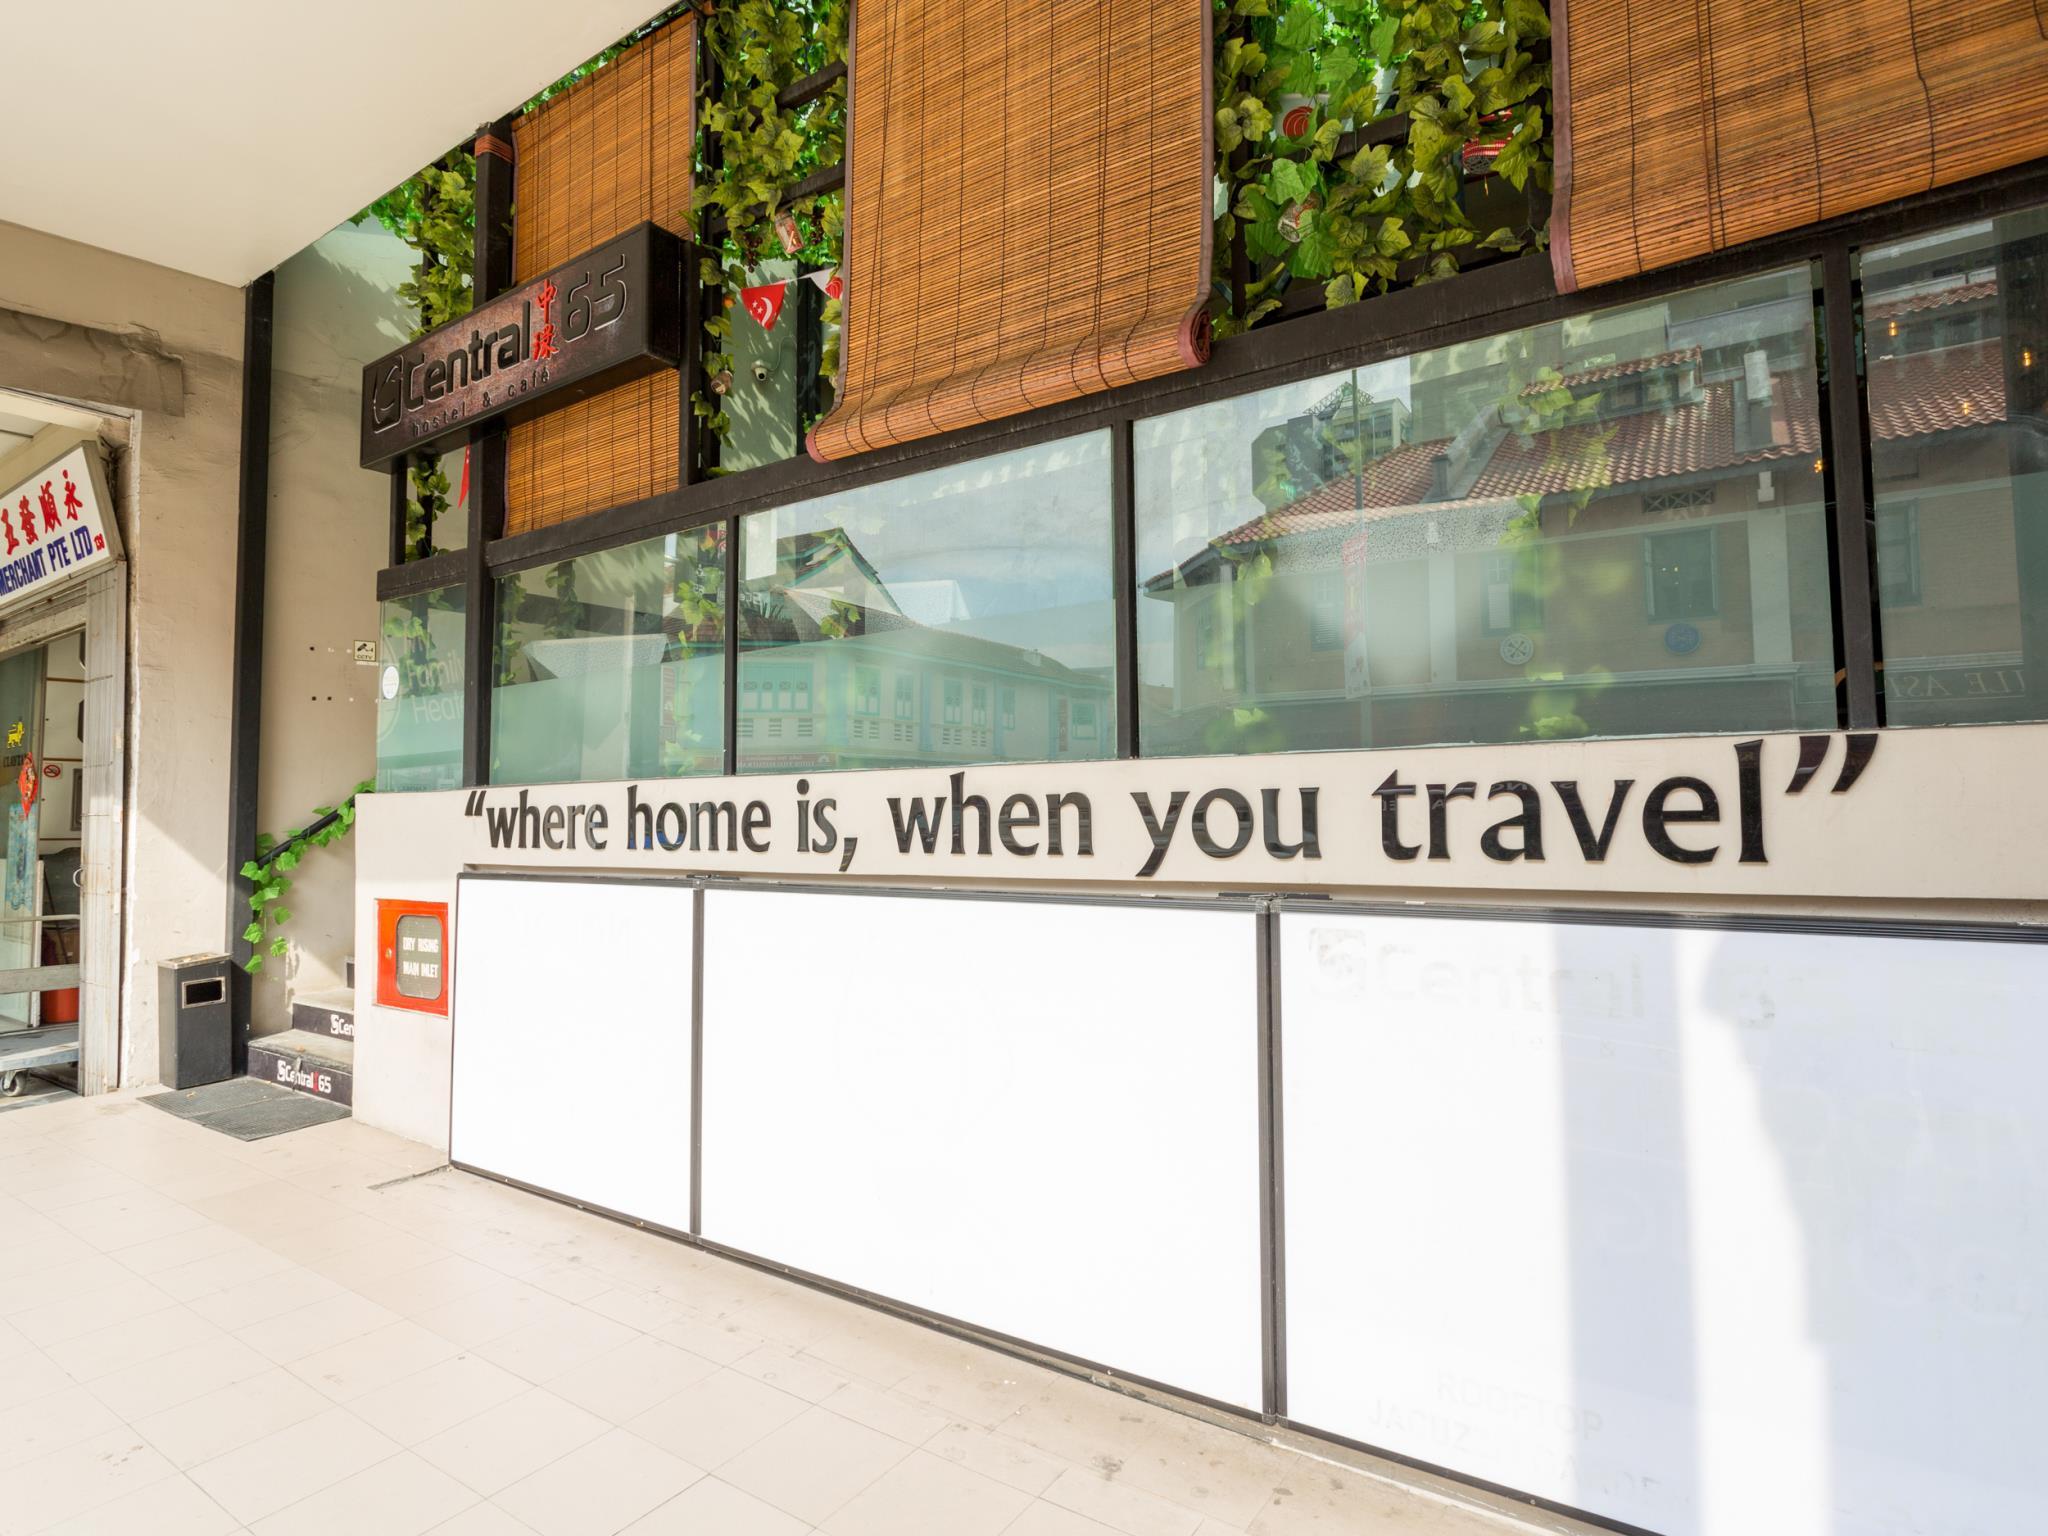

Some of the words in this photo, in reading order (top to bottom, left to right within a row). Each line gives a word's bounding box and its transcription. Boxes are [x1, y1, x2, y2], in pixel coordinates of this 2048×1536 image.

[402, 300, 532, 412] Central
[562, 253, 628, 343] 65
[412, 401, 467, 437] hostel
[482, 391, 493, 408] &
[0, 548, 47, 596] MERCHANT
[47, 536, 71, 572] PTE
[70, 525, 93, 561] LTD
[626, 784, 772, 853] home
[796, 778, 858, 872] is,
[886, 771, 1094, 857] when
[1130, 786, 1322, 877] you
[402, 936, 416, 951] DRY
[318, 1074, 331, 1093] 65
